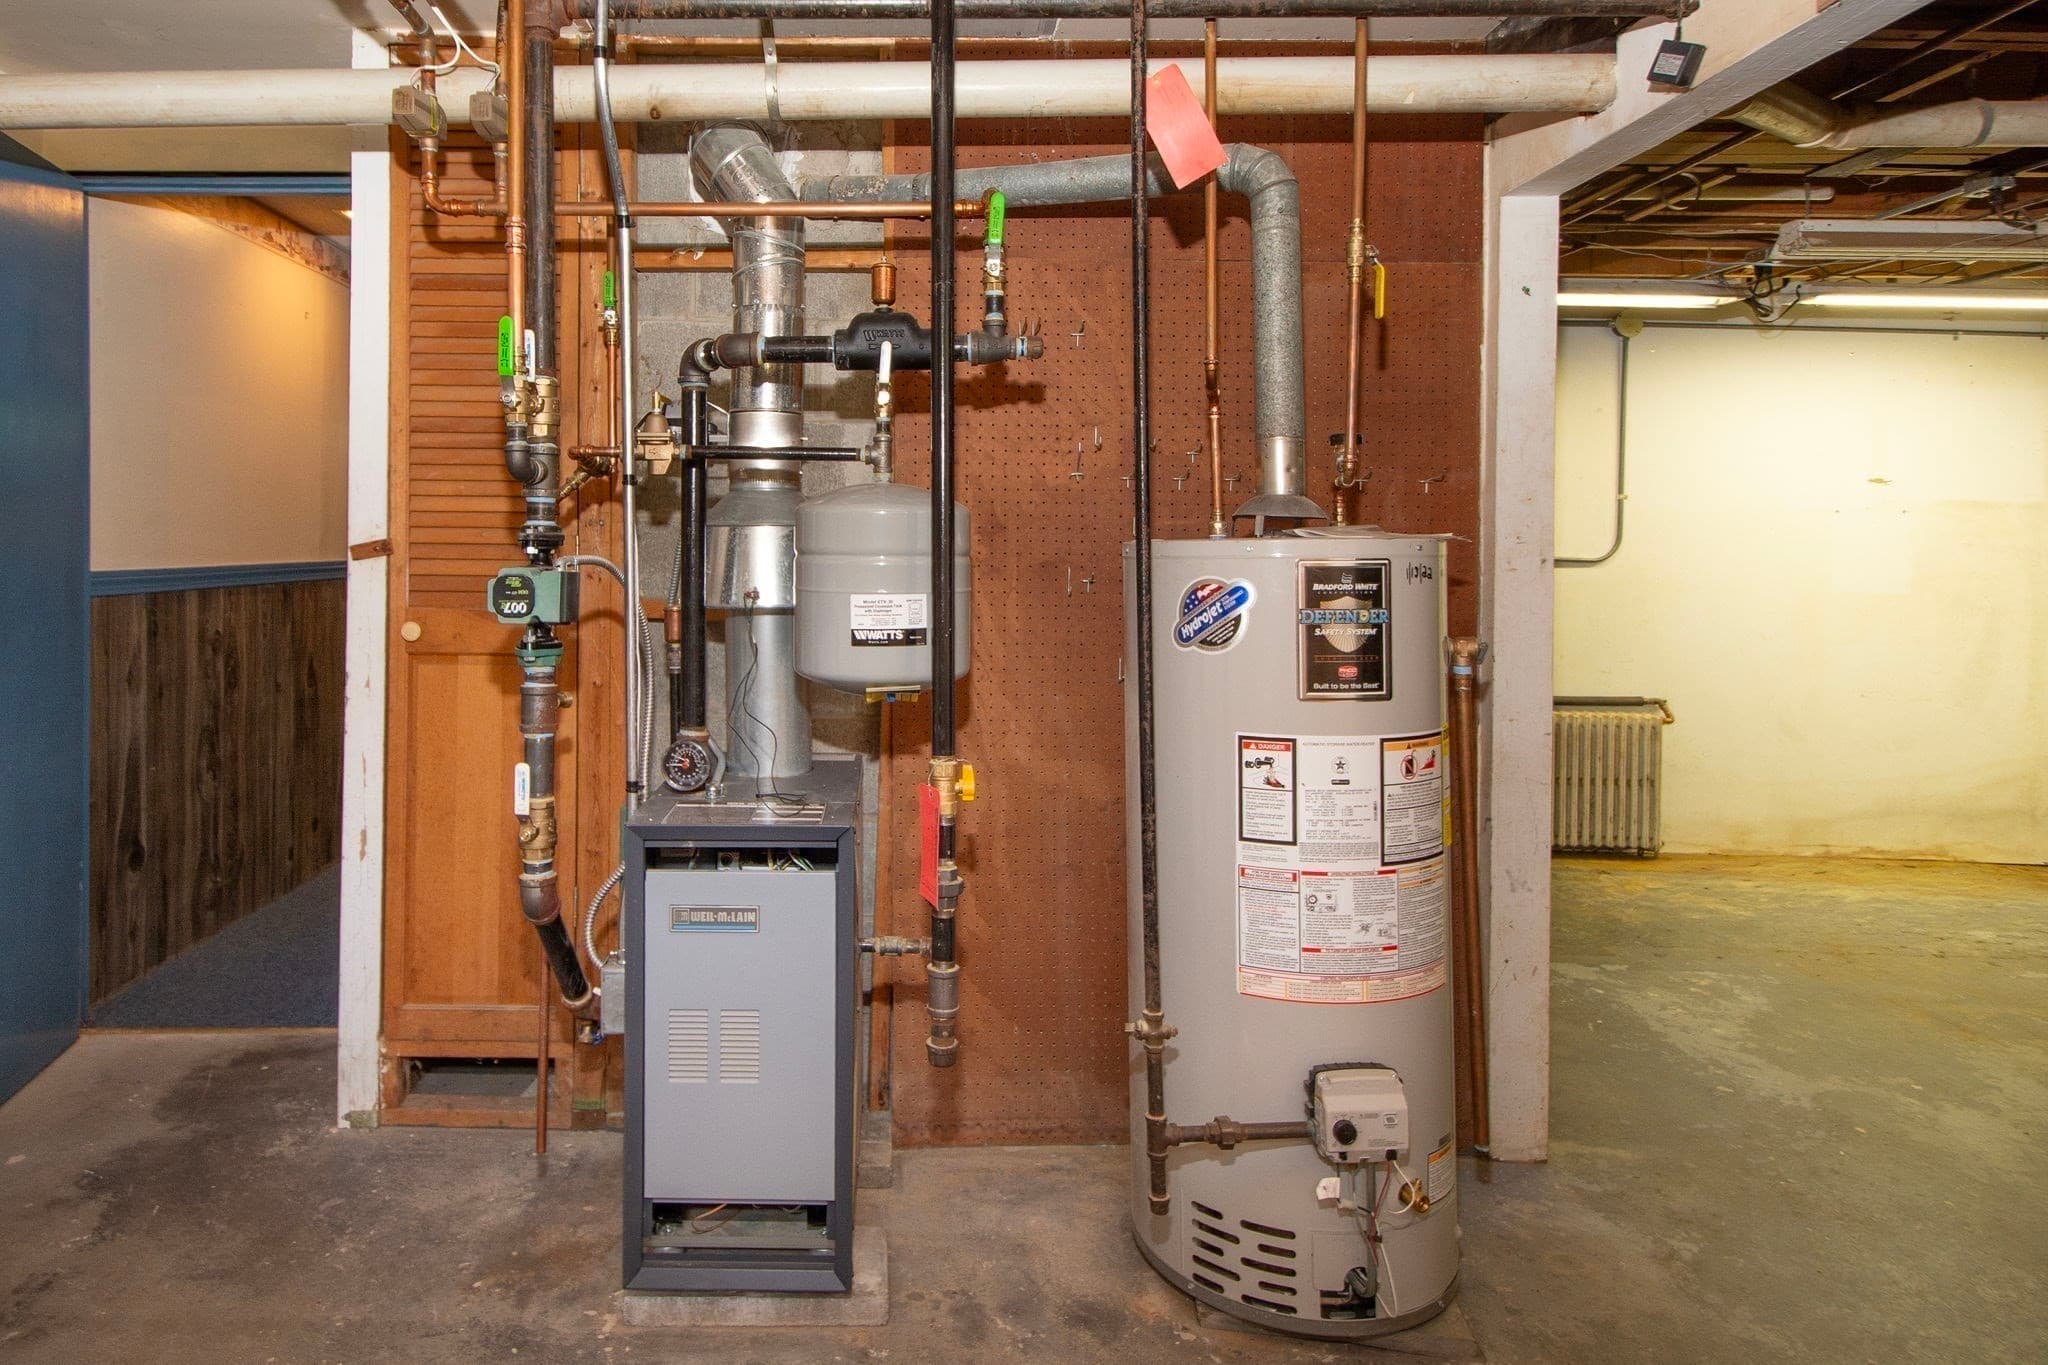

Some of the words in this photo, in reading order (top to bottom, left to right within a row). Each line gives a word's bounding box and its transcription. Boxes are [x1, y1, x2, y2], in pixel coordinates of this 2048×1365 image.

[1312, 583, 1354, 591] BRADFORD
[1181, 601, 1223, 639] Hydrojet
[1300, 609, 1389, 624] DEFENDER
[1314, 628, 1344, 636] SAFETY
[1346, 628, 1378, 636] SYSTEM
